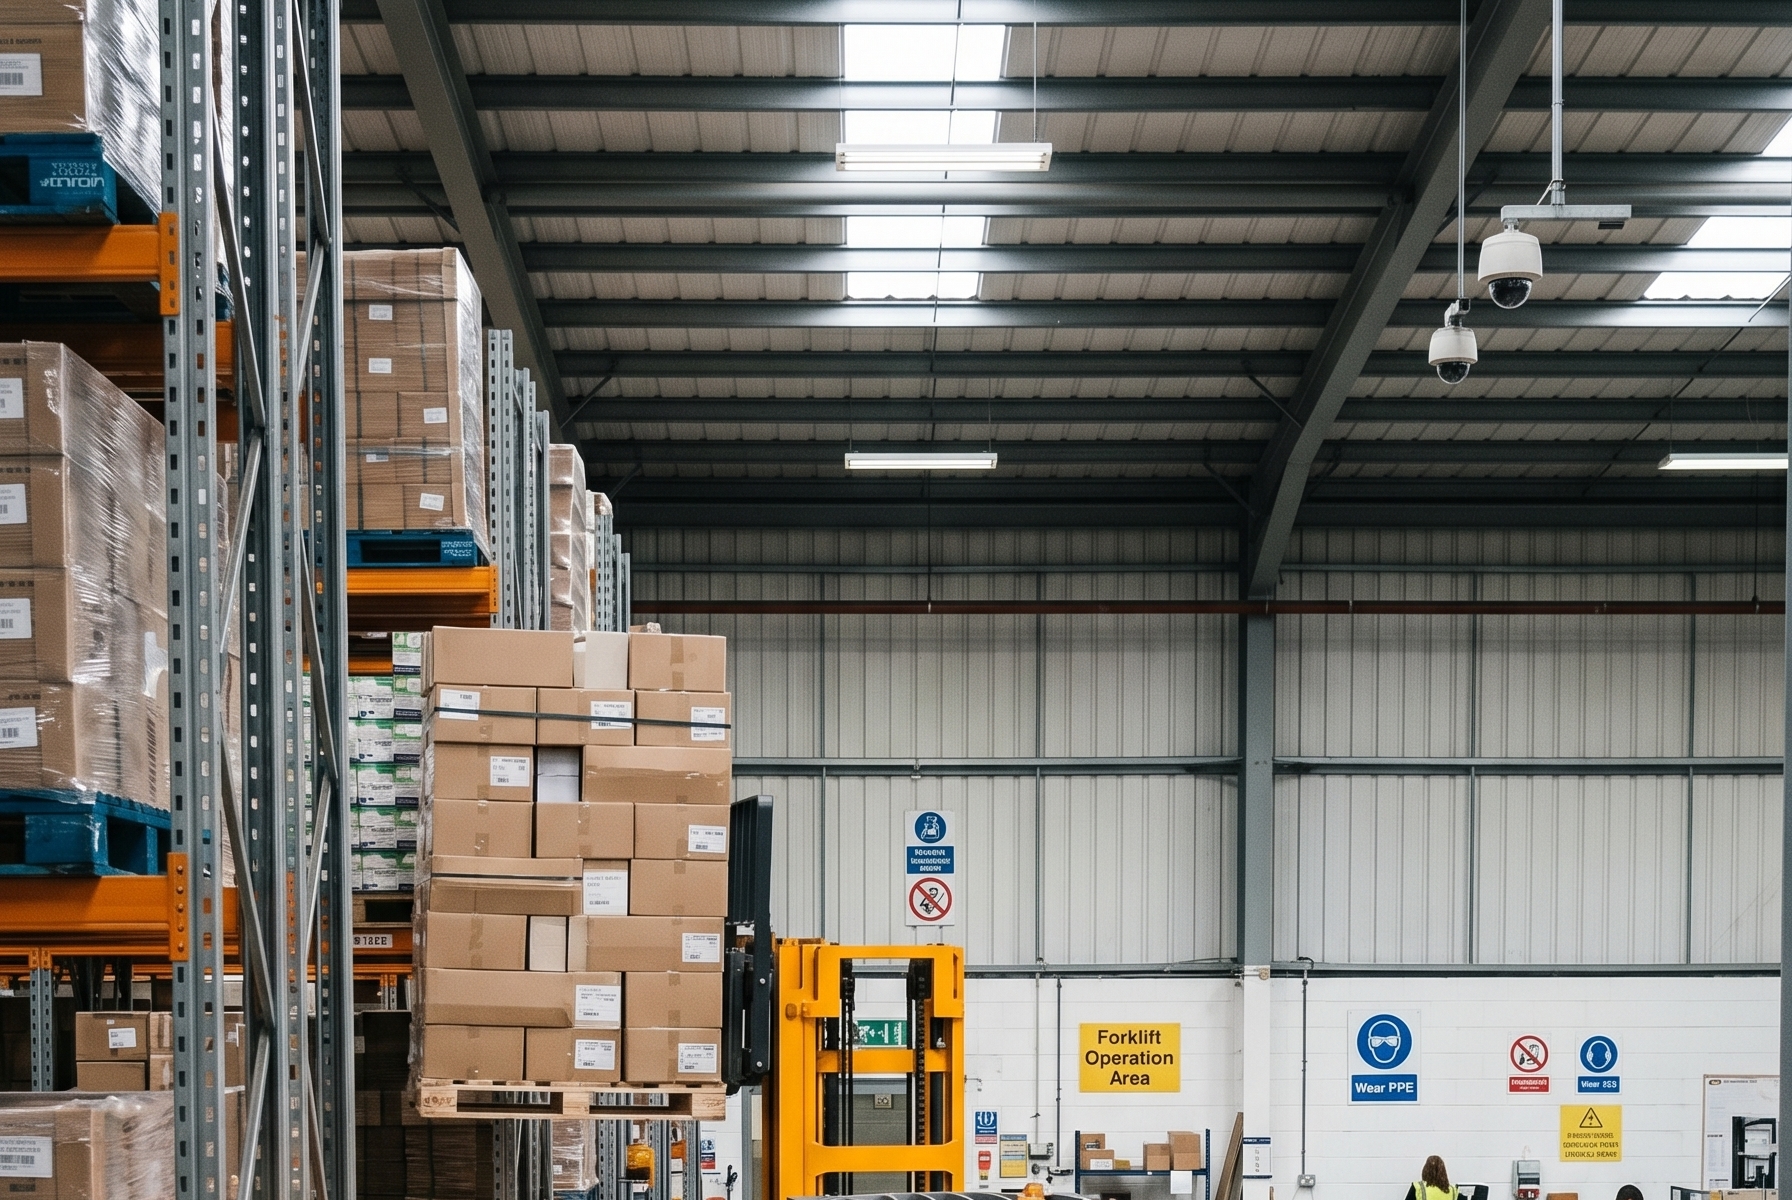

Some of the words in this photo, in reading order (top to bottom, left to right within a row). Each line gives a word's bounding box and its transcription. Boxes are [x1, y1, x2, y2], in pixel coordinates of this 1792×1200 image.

[1097, 1029, 1161, 1045] Forklift
[1085, 1050, 1174, 1069] Operation
[1109, 1070, 1150, 1085] Area
[1355, 1082, 1386, 1093] Wear
[1388, 1082, 1414, 1093] PPE
